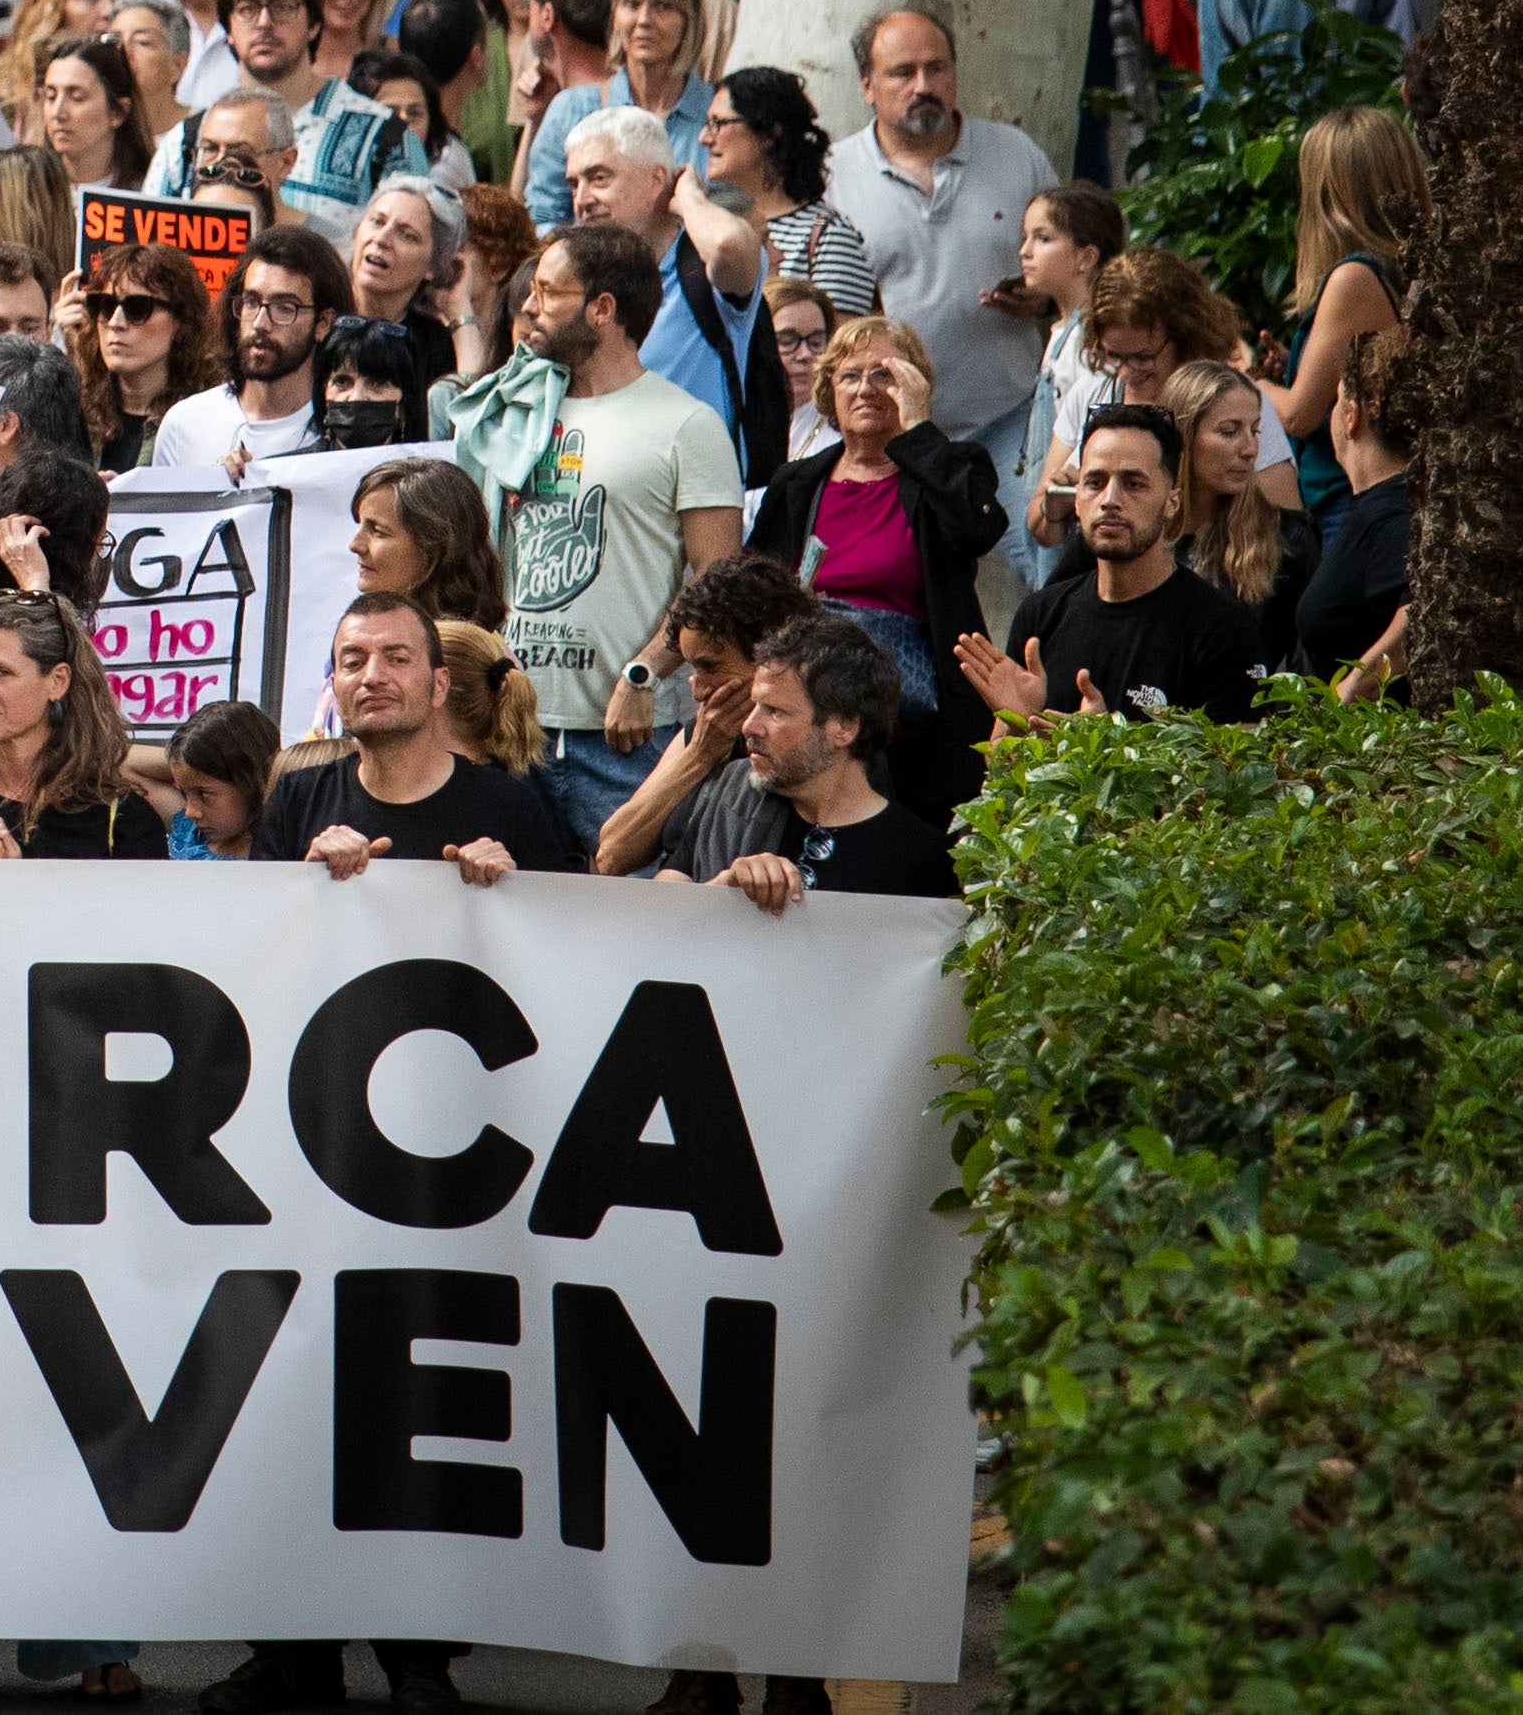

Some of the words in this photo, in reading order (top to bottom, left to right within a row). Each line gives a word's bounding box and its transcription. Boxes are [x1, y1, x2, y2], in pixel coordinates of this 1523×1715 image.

[84, 201, 126, 243] SE
[133, 208, 248, 253] VENDE
[149, 609, 216, 663] ho
